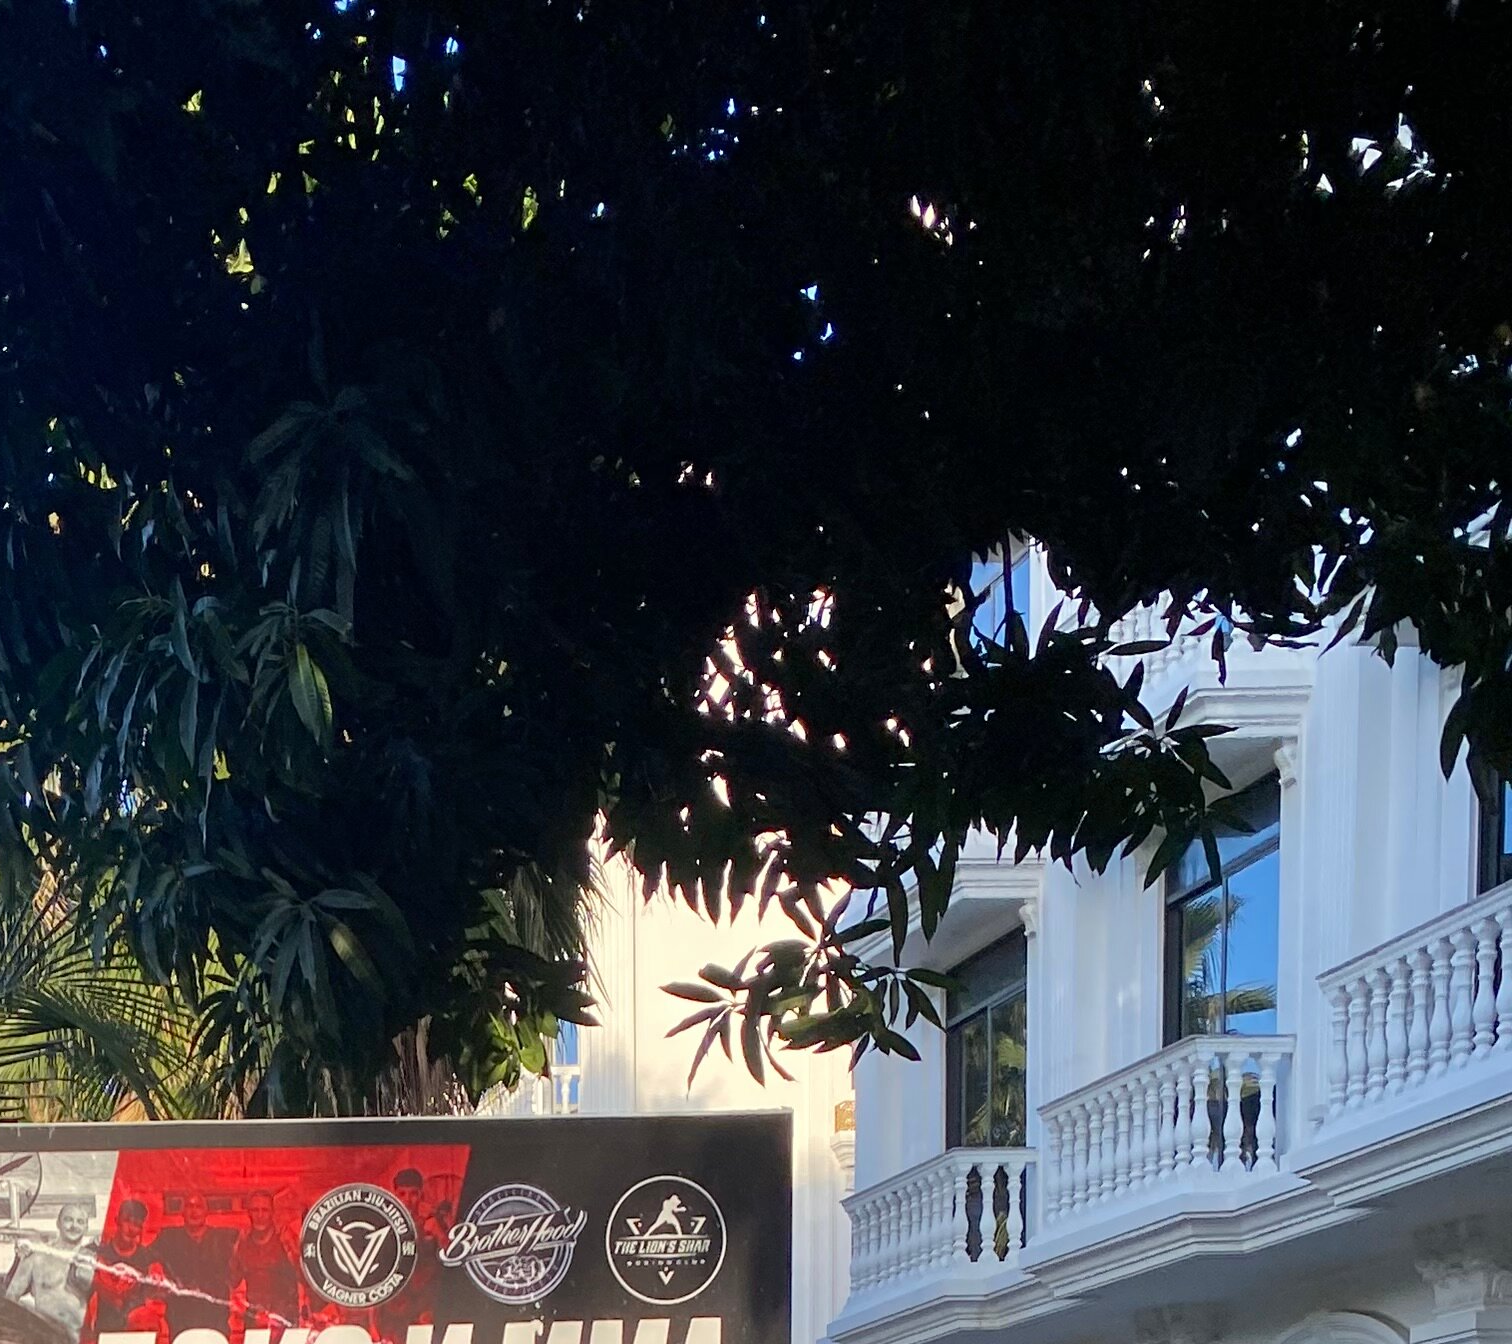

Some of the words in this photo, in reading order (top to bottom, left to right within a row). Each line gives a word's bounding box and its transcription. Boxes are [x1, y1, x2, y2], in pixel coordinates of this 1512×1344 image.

[614, 1241, 638, 1255] THE
[322, 1280, 366, 1304] VAGNER
[369, 1272, 404, 1301] COSTA
